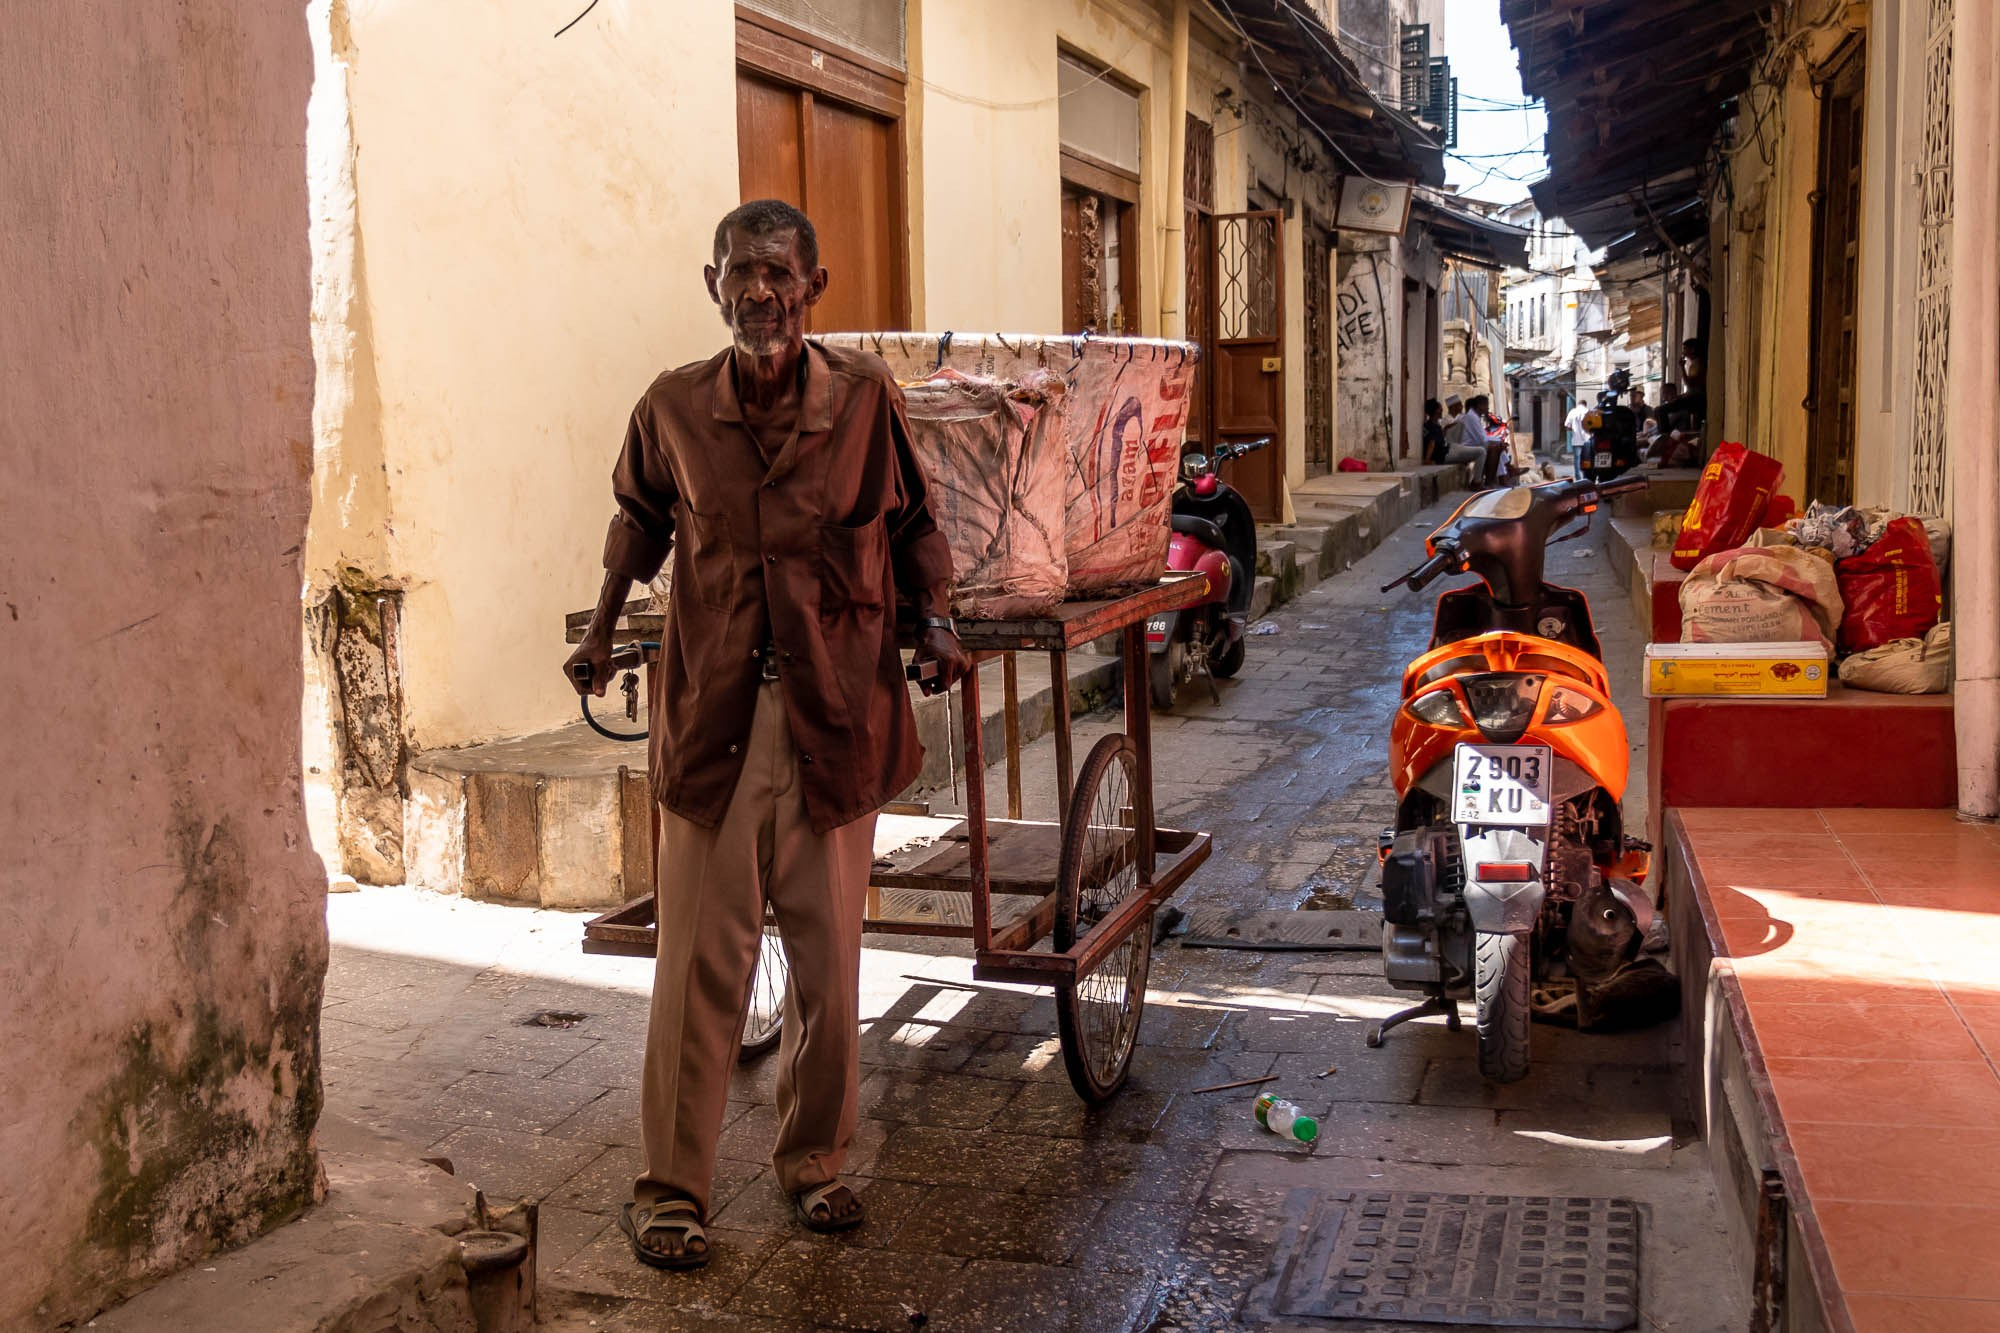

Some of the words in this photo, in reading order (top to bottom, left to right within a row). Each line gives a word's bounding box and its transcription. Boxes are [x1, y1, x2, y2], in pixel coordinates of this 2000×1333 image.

[1121, 440, 1139, 501] azam
[1147, 621, 1166, 632] 786
[1488, 788, 1522, 813] KU
